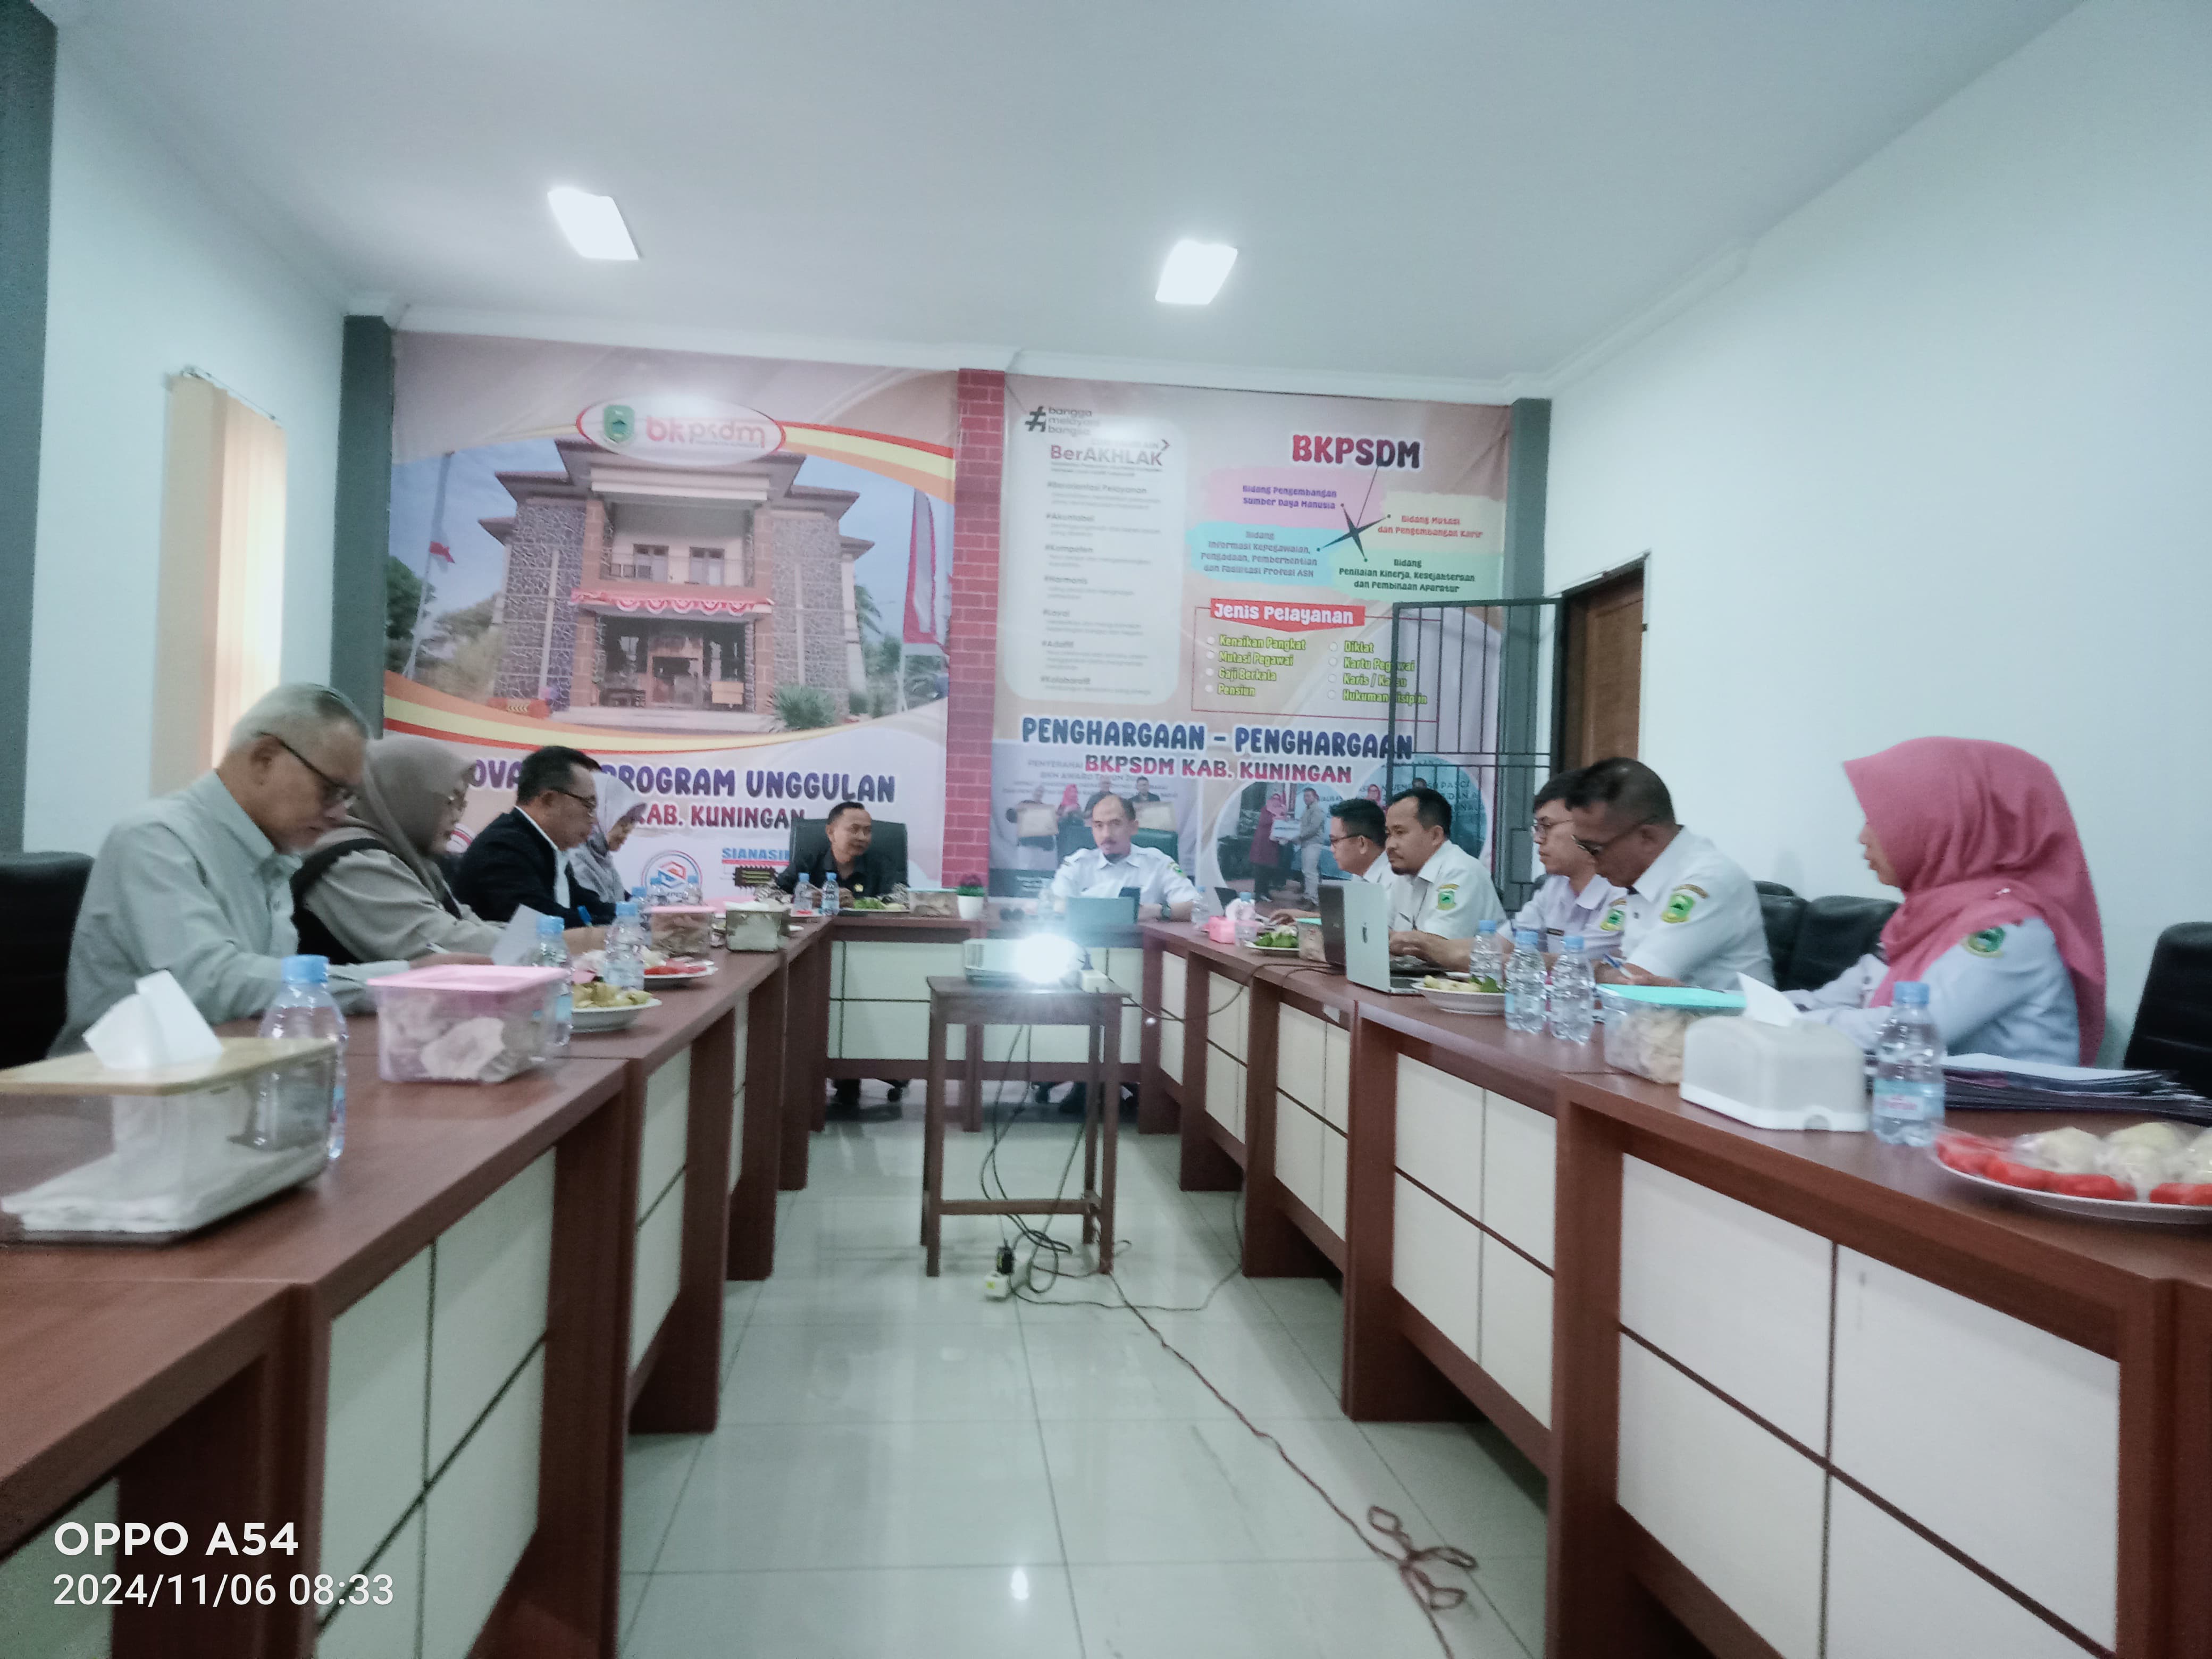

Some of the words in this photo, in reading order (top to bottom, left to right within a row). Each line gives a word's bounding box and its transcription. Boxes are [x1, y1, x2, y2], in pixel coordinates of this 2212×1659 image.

[1049, 406, 1092, 418] bangga
[1050, 444, 1163, 466] BerAKHLAK
[1292, 434, 1421, 469] BKPSDM
[1243, 484, 1271, 495] Bidang
[1273, 486, 1337, 498] Pengembangan
[1243, 496, 1277, 505] Sumber
[1278, 499, 1299, 509] Daya
[1301, 501, 1336, 509] Manusia
[1401, 515, 1430, 524] Bidang
[1431, 516, 1461, 525] Mutasi
[1246, 531, 1275, 541] Bidang
[1395, 526, 1458, 538] Pengembangan
[1208, 541, 1251, 550] Informasi
[1251, 555, 1318, 566] Pemberhentian
[1393, 559, 1422, 568] Bidang
[1263, 567, 1295, 576] Profesi
[1296, 569, 1314, 578] ASN
[1339, 567, 1378, 577] Penilaian
[1379, 569, 1412, 580] Kinerja,
[1413, 572, 1476, 582] Kesejahteraan
[1353, 580, 1370, 589] dan
[1371, 582, 1418, 591] Pembinaan
[1419, 584, 1461, 593] Aparatur
[1214, 603, 1260, 619] Jenis
[1263, 606, 1354, 625] Pelayanan
[1219, 634, 1264, 648] Kenaikan
[1265, 636, 1306, 651] Pangkat
[1344, 640, 1375, 653] Diklat
[1219, 651, 1251, 664] Mutasi
[1253, 652, 1294, 667] Pegawai
[1344, 656, 1371, 669] Kartu
[1373, 658, 1415, 673] Pegwai
[1218, 667, 1237, 682] Gaji
[1238, 669, 1277, 682] Berkala
[1343, 673, 1370, 685] Karis
[1378, 674, 1407, 688] Kasu
[1217, 683, 1256, 697] Pensiun
[1343, 689, 1389, 702] Hukuman
[1390, 692, 1428, 707] isipin
[1021, 717, 1205, 750] PENGHARGAAN
[1235, 726, 1412, 760] PENGHARGAAN
[1085, 754, 1174, 775] BKPSDM
[1182, 758, 1233, 778] KAB.
[1239, 760, 1352, 783] KUNINGAN
[745, 769, 895, 803] UNGGULAN
[639, 803, 683, 826] AB.
